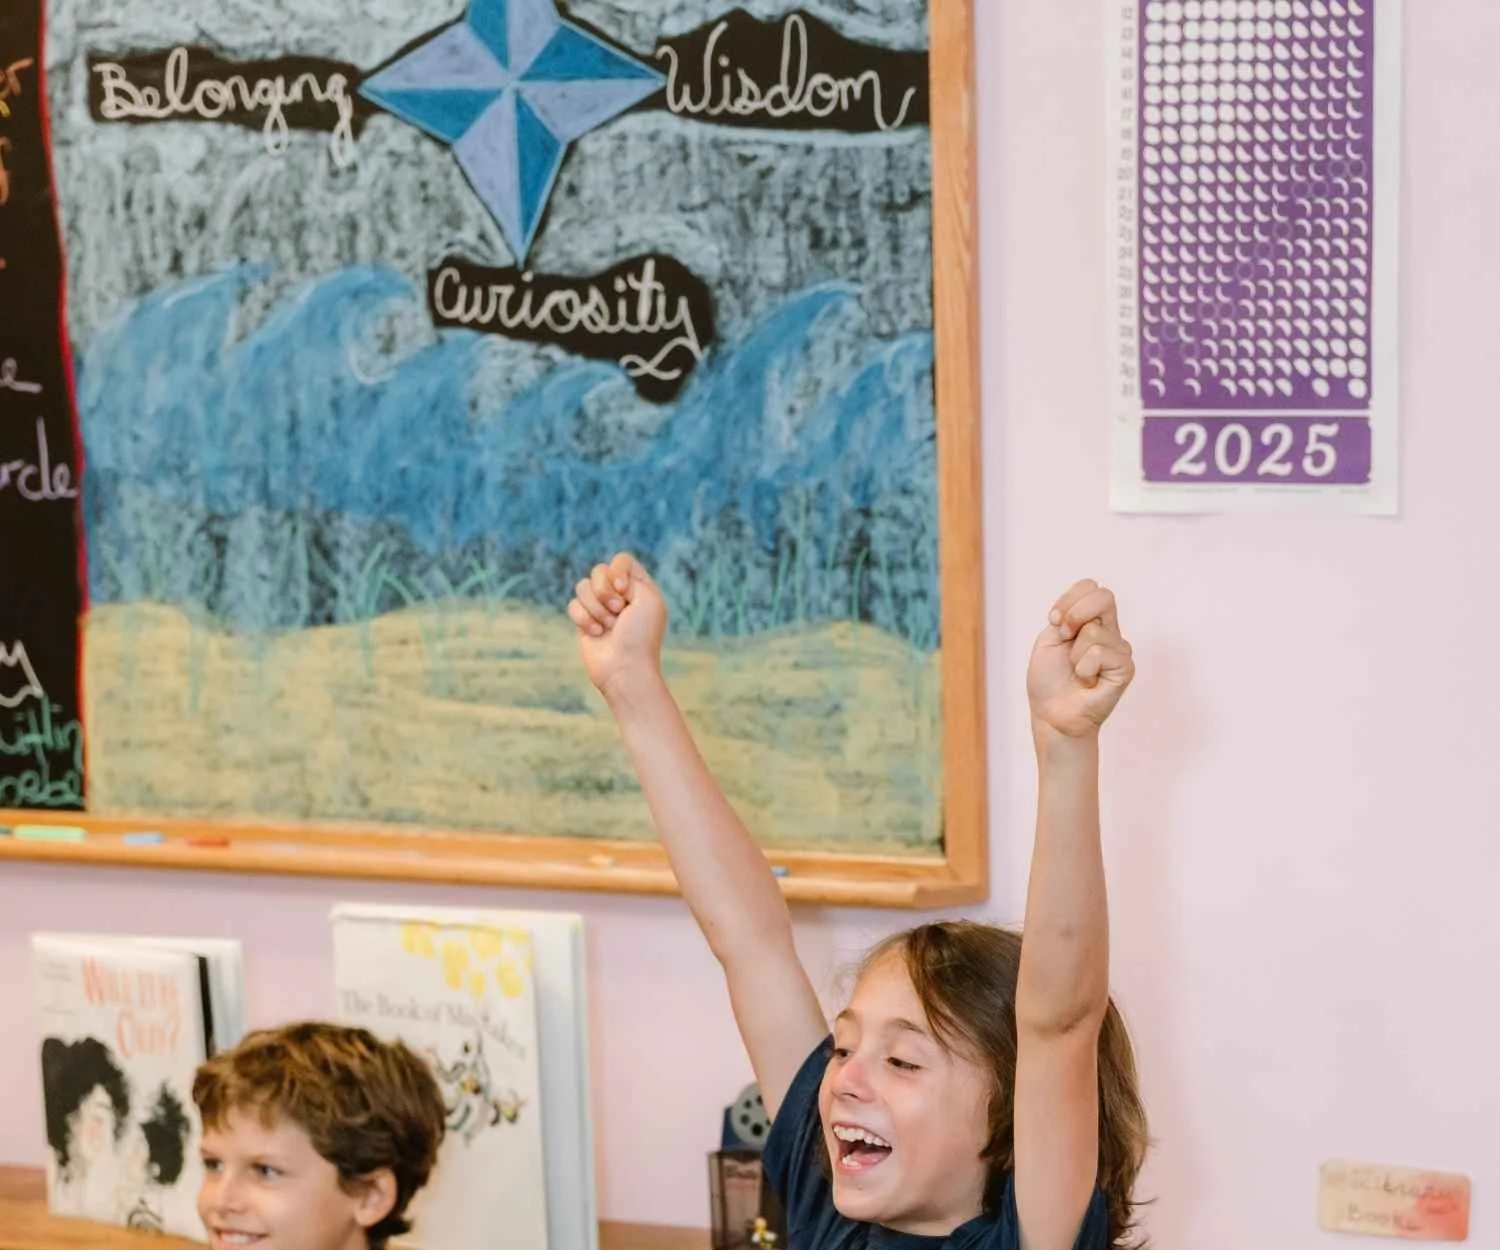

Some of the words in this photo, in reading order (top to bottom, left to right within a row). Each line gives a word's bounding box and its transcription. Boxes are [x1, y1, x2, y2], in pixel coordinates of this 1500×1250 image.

[657, 14, 916, 131] Wisdom
[434, 258, 702, 380] Curiosity
[1170, 422, 1340, 477] 2025
